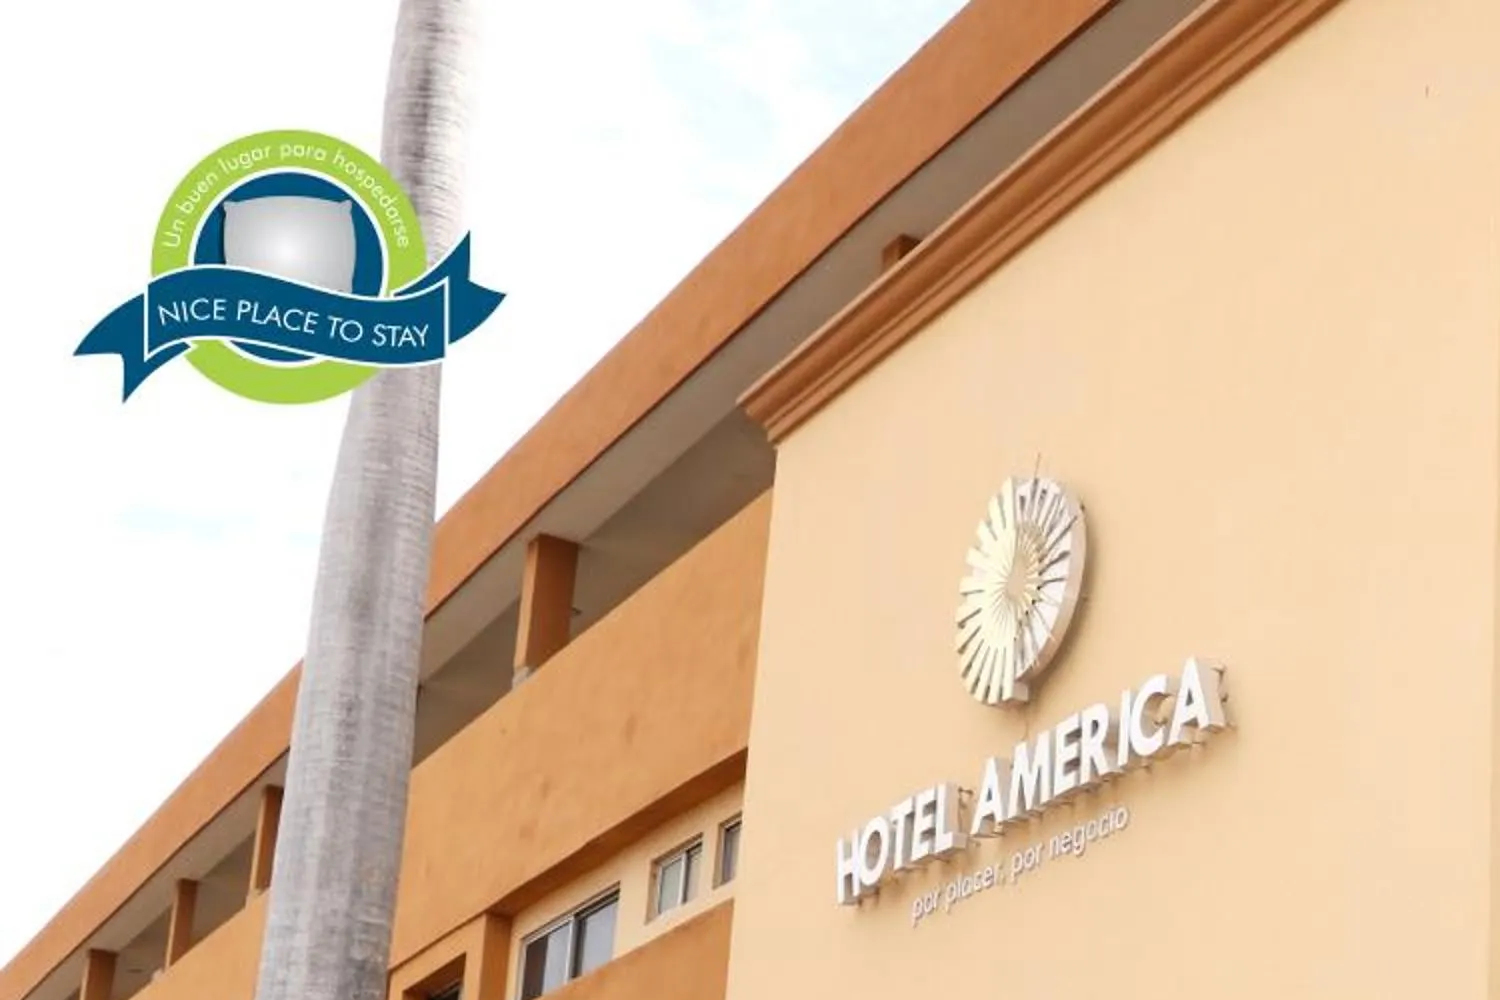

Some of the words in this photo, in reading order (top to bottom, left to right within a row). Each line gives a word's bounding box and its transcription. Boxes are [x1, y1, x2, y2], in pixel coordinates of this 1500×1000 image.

[836, 783, 962, 904] HOTEL
[969, 656, 1223, 838] AMERICA
[911, 884, 942, 928] por
[1010, 842, 1045, 883] por
[1050, 805, 1130, 857] negocio
